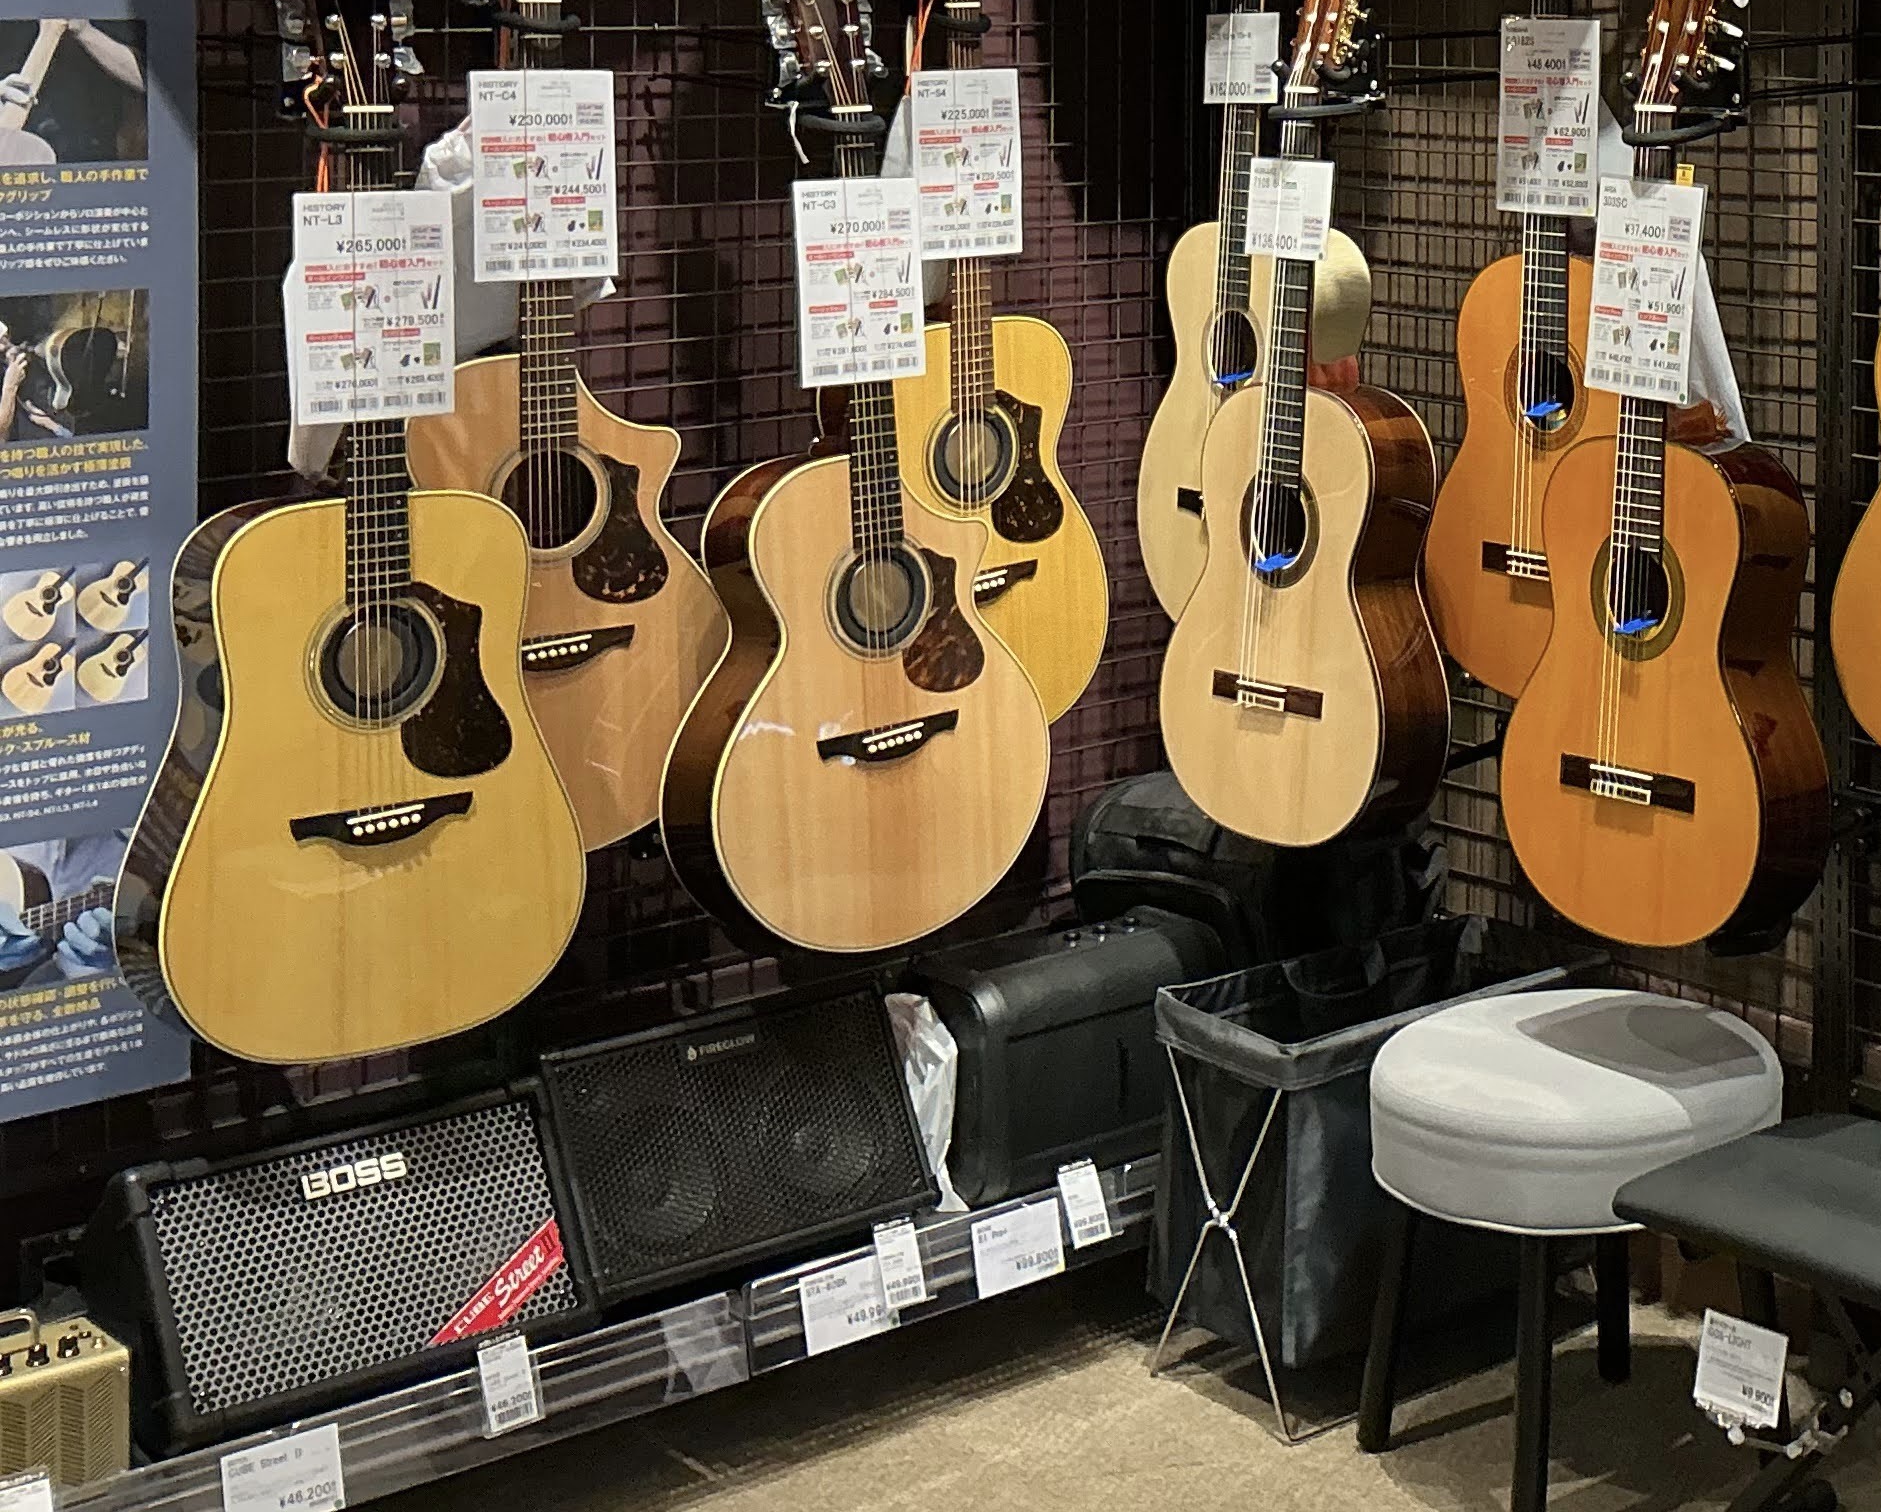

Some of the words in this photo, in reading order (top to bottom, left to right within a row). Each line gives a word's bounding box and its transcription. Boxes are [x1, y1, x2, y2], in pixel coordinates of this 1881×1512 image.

[303, 203, 346, 213] HISTORY
[303, 214, 343, 226] NT-L3
[336, 238, 401, 254] ¥265,000
[302, 1151, 407, 1201] BOSS
[494, 1245, 546, 1306] Street
